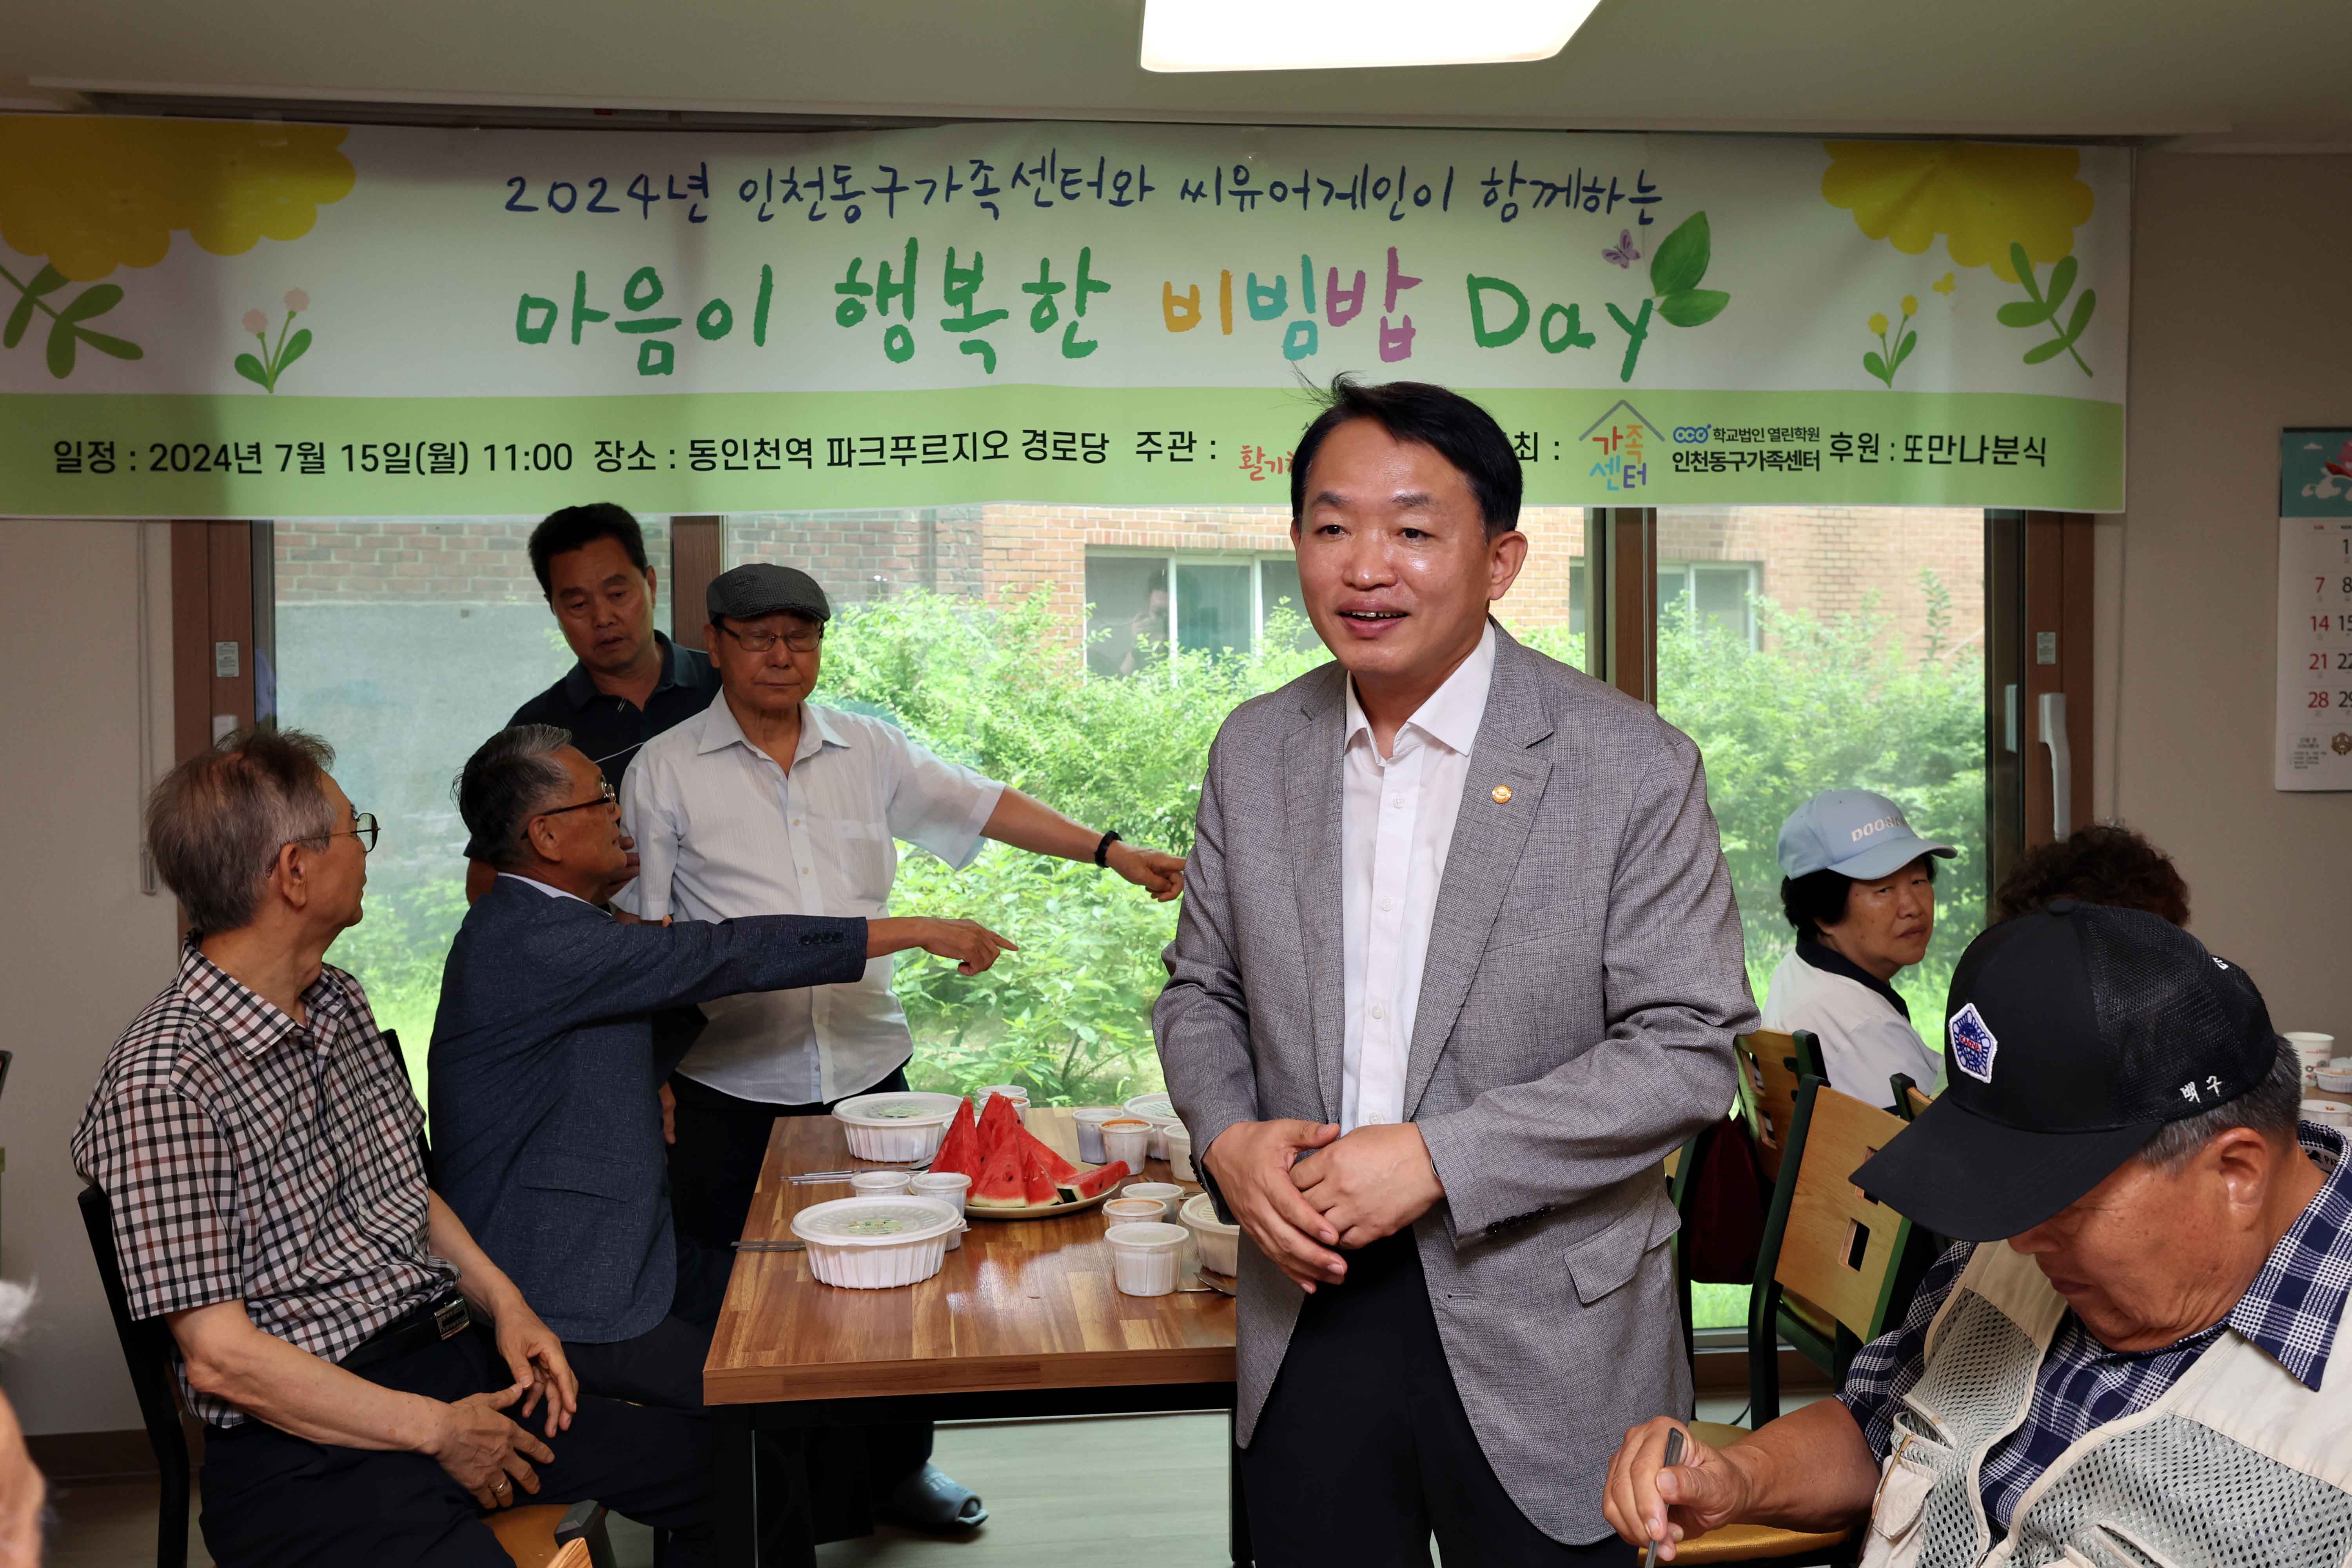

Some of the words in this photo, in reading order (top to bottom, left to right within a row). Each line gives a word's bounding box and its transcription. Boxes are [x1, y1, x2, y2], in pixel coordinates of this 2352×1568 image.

[505, 162, 709, 224] 2024년
[739, 148, 1155, 224] 인천동구가족센터와
[1180, 163, 1454, 221] 씨유어게인이
[1481, 160, 1662, 225] 함께하는
[516, 264, 773, 376] 마음이
[835, 237, 1111, 374] 행복한
[1162, 246, 1423, 362] 비빔밥
[1466, 273, 1653, 383] Day
[595, 440, 656, 473] 장소
[689, 438, 812, 471] 동인천역
[827, 430, 1009, 468] 파크푸르지오
[1022, 429, 1109, 464] 경로당
[1136, 431, 1197, 463] 주관
[1504, 431, 1538, 463] 최
[1592, 425, 1644, 464] 가족
[1713, 427, 1765, 443] 학교법인
[1768, 427, 1820, 442] 열린학원
[1829, 432, 1879, 463] 후원
[1903, 435, 2045, 467] 또만나분식
[54, 441, 116, 474] 일정
[150, 442, 262, 474] 2024년
[275, 442, 325, 474] 7월
[341, 441, 468, 475] 15일(월)
[484, 443, 572, 471] 11:00
[1590, 455, 1646, 491] 센터
[1672, 450, 1820, 472] 인천동구가족센터
[2343, 539, 2348, 554] 1
[2315, 577, 2325, 593] 7
[2342, 577, 2352, 593] 8
[2311, 615, 2329, 631] 14
[2309, 653, 2327, 669] 21
[2308, 691, 2329, 708] 28
